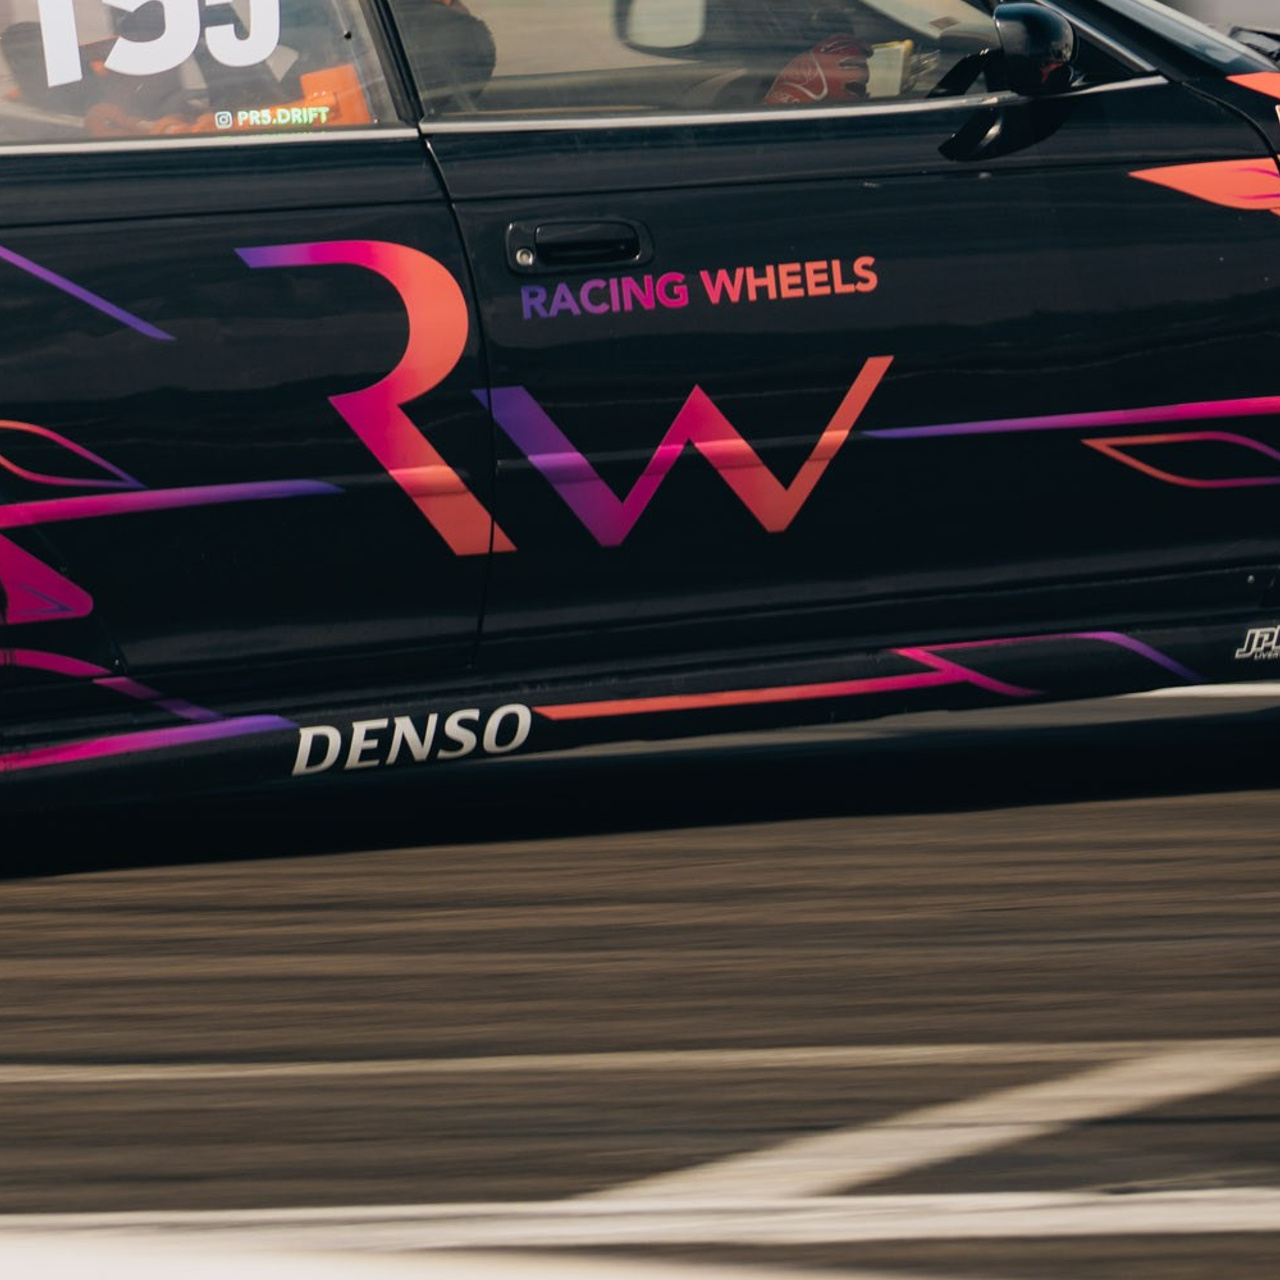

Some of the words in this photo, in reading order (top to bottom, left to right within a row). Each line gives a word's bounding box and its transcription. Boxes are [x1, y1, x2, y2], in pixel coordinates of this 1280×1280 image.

[522, 271, 689, 320] RACING
[699, 255, 878, 305] WHEELS
[234, 239, 894, 556] RW
[292, 703, 532, 776] DENSO
